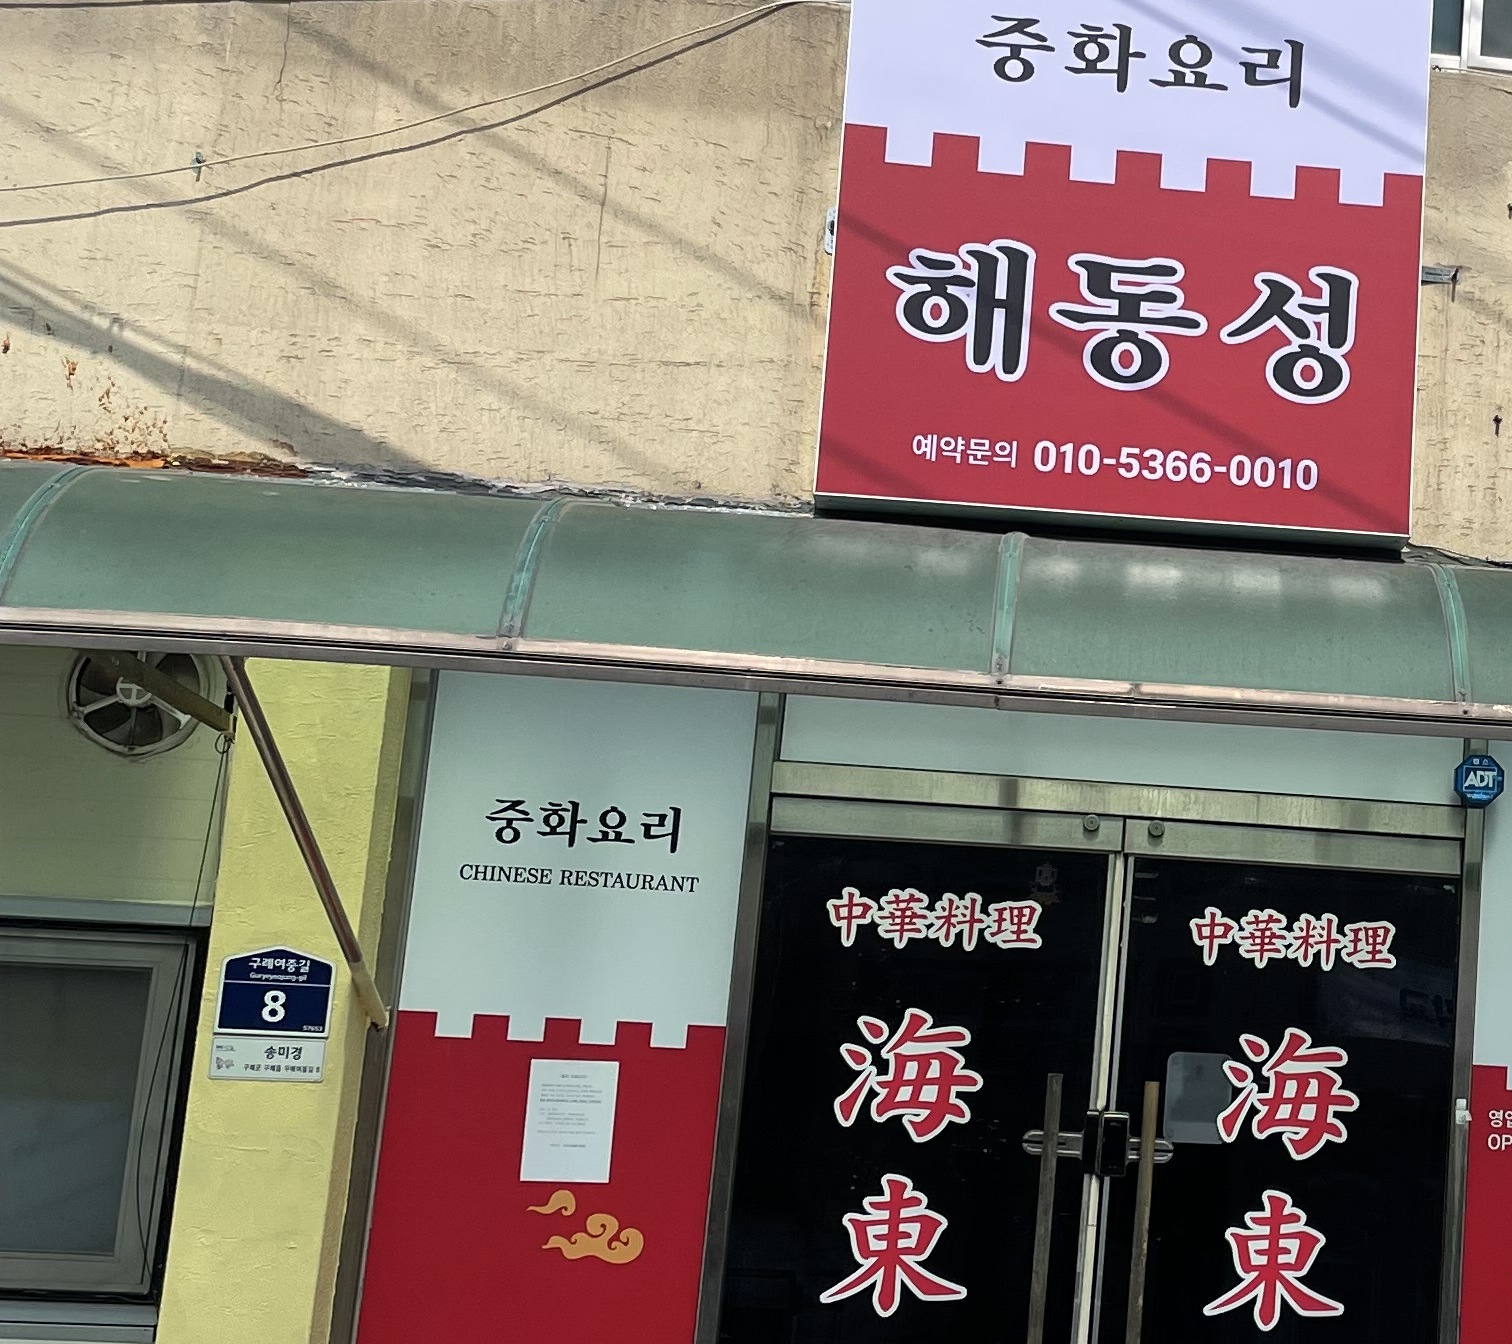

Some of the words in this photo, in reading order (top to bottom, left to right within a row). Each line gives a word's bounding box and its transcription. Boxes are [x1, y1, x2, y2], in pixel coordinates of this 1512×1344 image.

[976, 14, 1305, 108] 중화요리
[886, 239, 1359, 405] 해동성
[911, 433, 1018, 469] 예약문의
[1033, 439, 1319, 492] 010-5366-0010
[1464, 770, 1498, 788] ADT
[484, 798, 683, 854] 중화요리
[458, 863, 553, 887] CHINESE
[559, 869, 700, 894] RESTAURANT
[827, 886, 1042, 951] 中華料理
[1190, 907, 1396, 970] 中華料理
[248, 957, 310, 972] 구례여중길
[261, 989, 287, 1023] 8
[263, 1045, 304, 1061] 송미경
